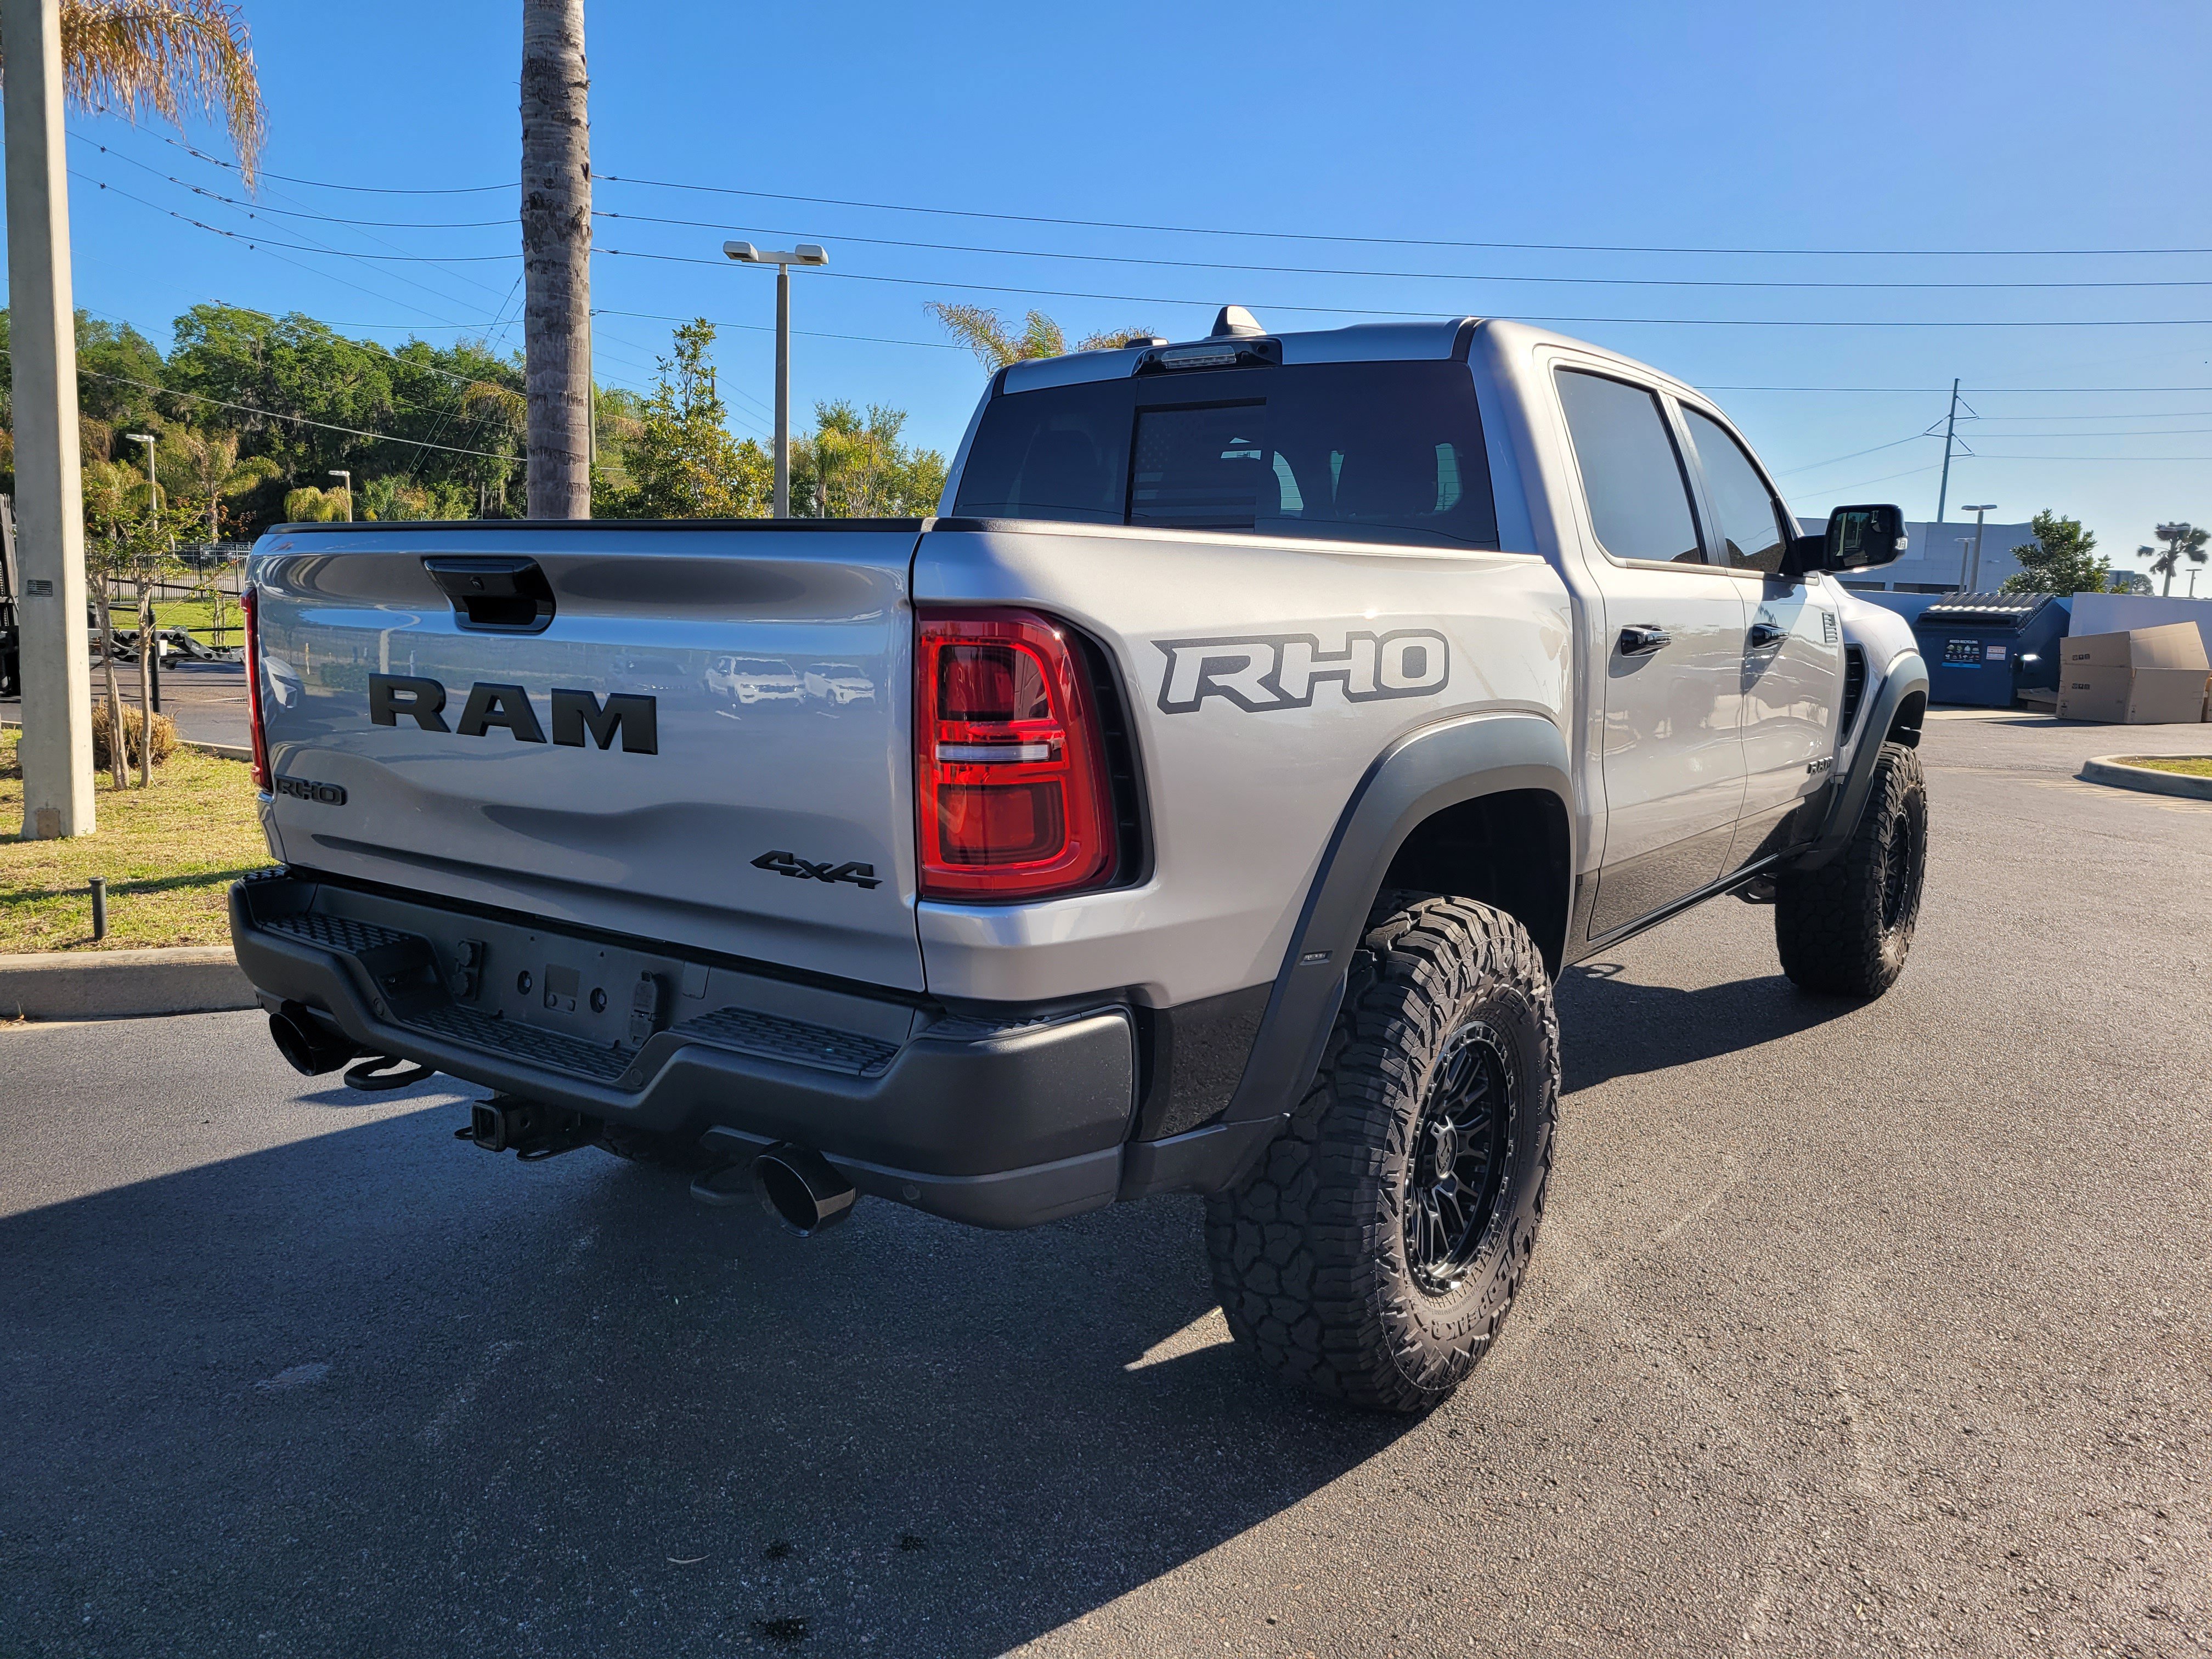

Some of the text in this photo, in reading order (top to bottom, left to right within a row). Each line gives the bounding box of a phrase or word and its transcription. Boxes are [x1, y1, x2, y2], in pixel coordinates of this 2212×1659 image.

[1150, 629, 1449, 715] RHO
[369, 673, 658, 755] RAM
[274, 774, 348, 806] RHO
